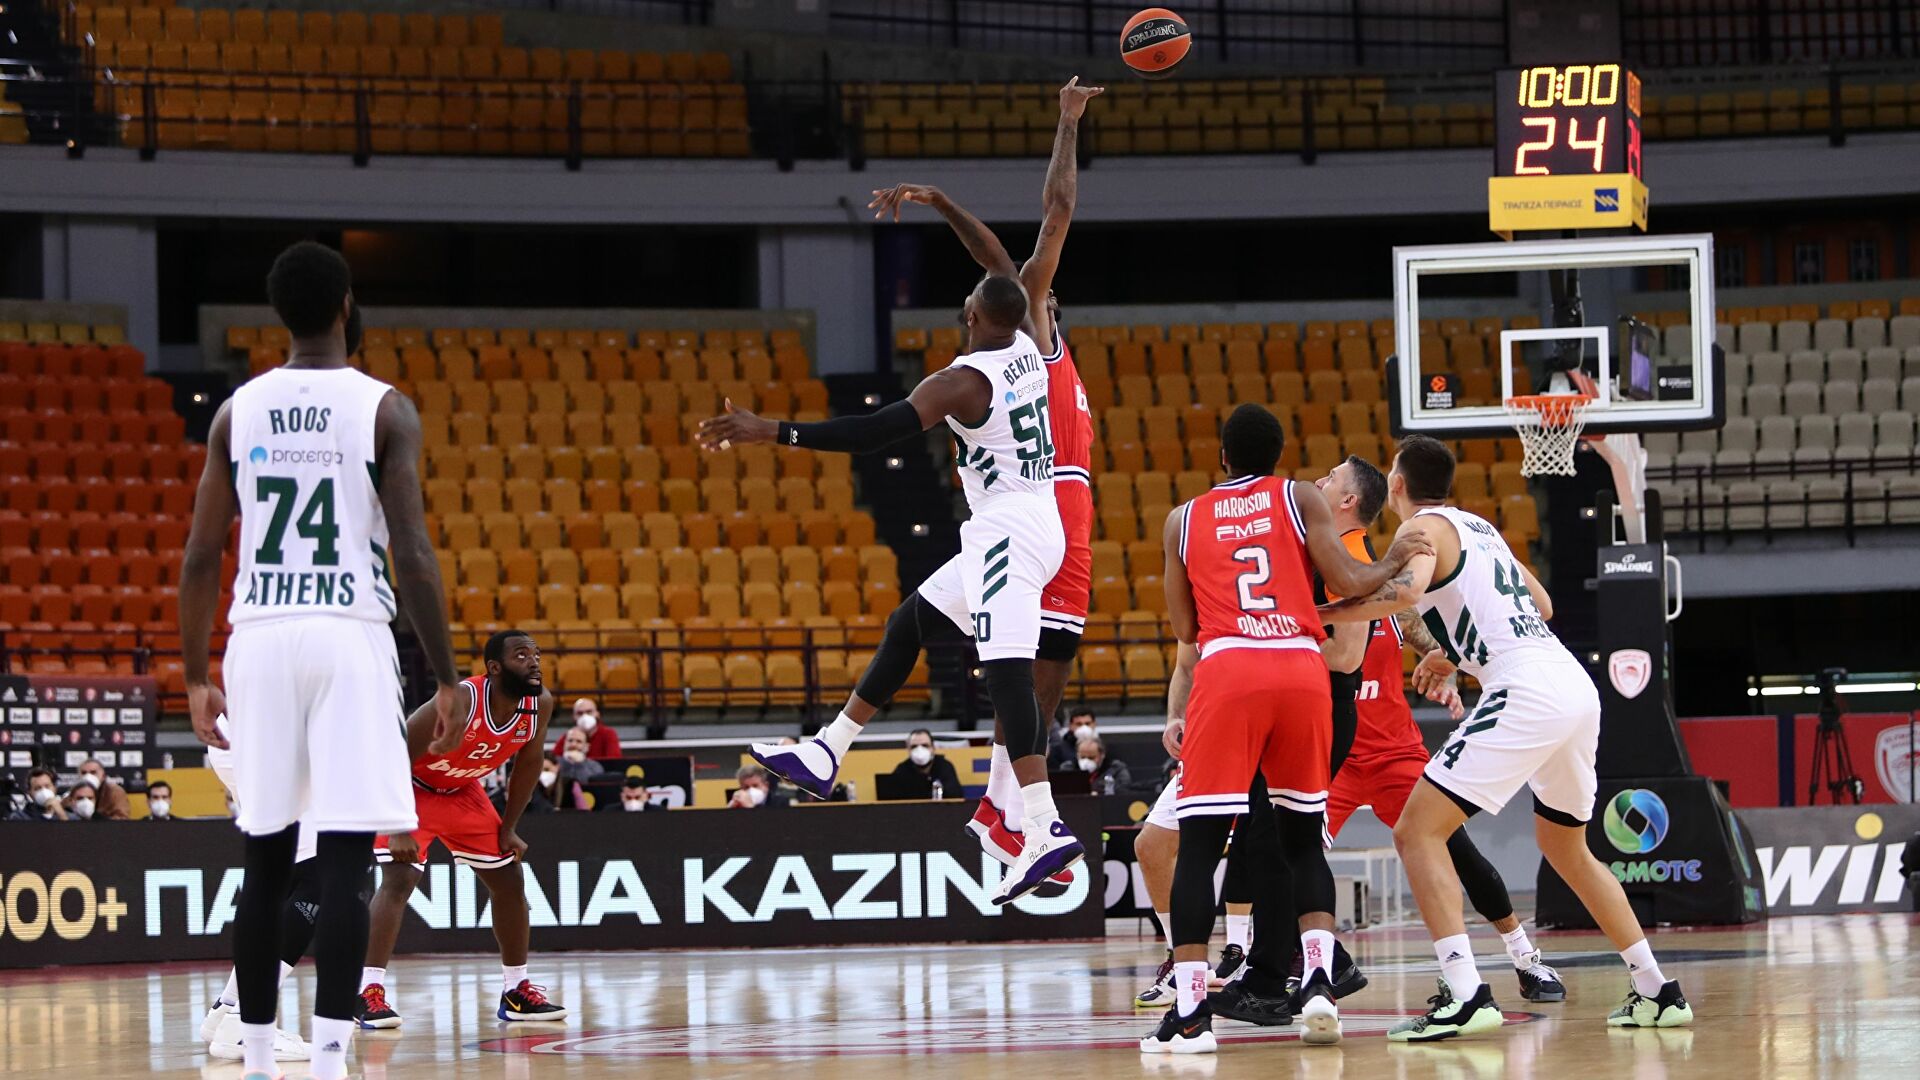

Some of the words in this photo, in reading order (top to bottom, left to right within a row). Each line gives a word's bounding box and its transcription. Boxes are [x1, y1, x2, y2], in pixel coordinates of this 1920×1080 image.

[1128, 24, 1177, 48] SPALDING
[1518, 64, 1620, 107] 10:00
[1515, 116, 1606, 175] 24
[1503, 200, 1542, 210] ΤΡΑΠΕΖΑ
[1003, 353, 1040, 387] BENTIL
[268, 405, 331, 434] ROOS
[1008, 394, 1055, 461] 50
[271, 446, 344, 467] protergia
[1020, 457, 1054, 481] ATHE
[1214, 491, 1272, 519] HARRISON
[255, 475, 340, 566] 74
[1215, 517, 1272, 541] FMS
[1232, 545, 1277, 611] 2
[1604, 560, 1653, 574] SPALDING
[244, 571, 356, 607] ATHENS
[1508, 614, 1555, 639] ATHEN
[467, 742, 501, 760] 22
[1028, 842, 1049, 864] BLM
[1755, 812, 1907, 908] wi
[1604, 858, 1702, 883] SMOTE
[0, 869, 128, 942] 00+
